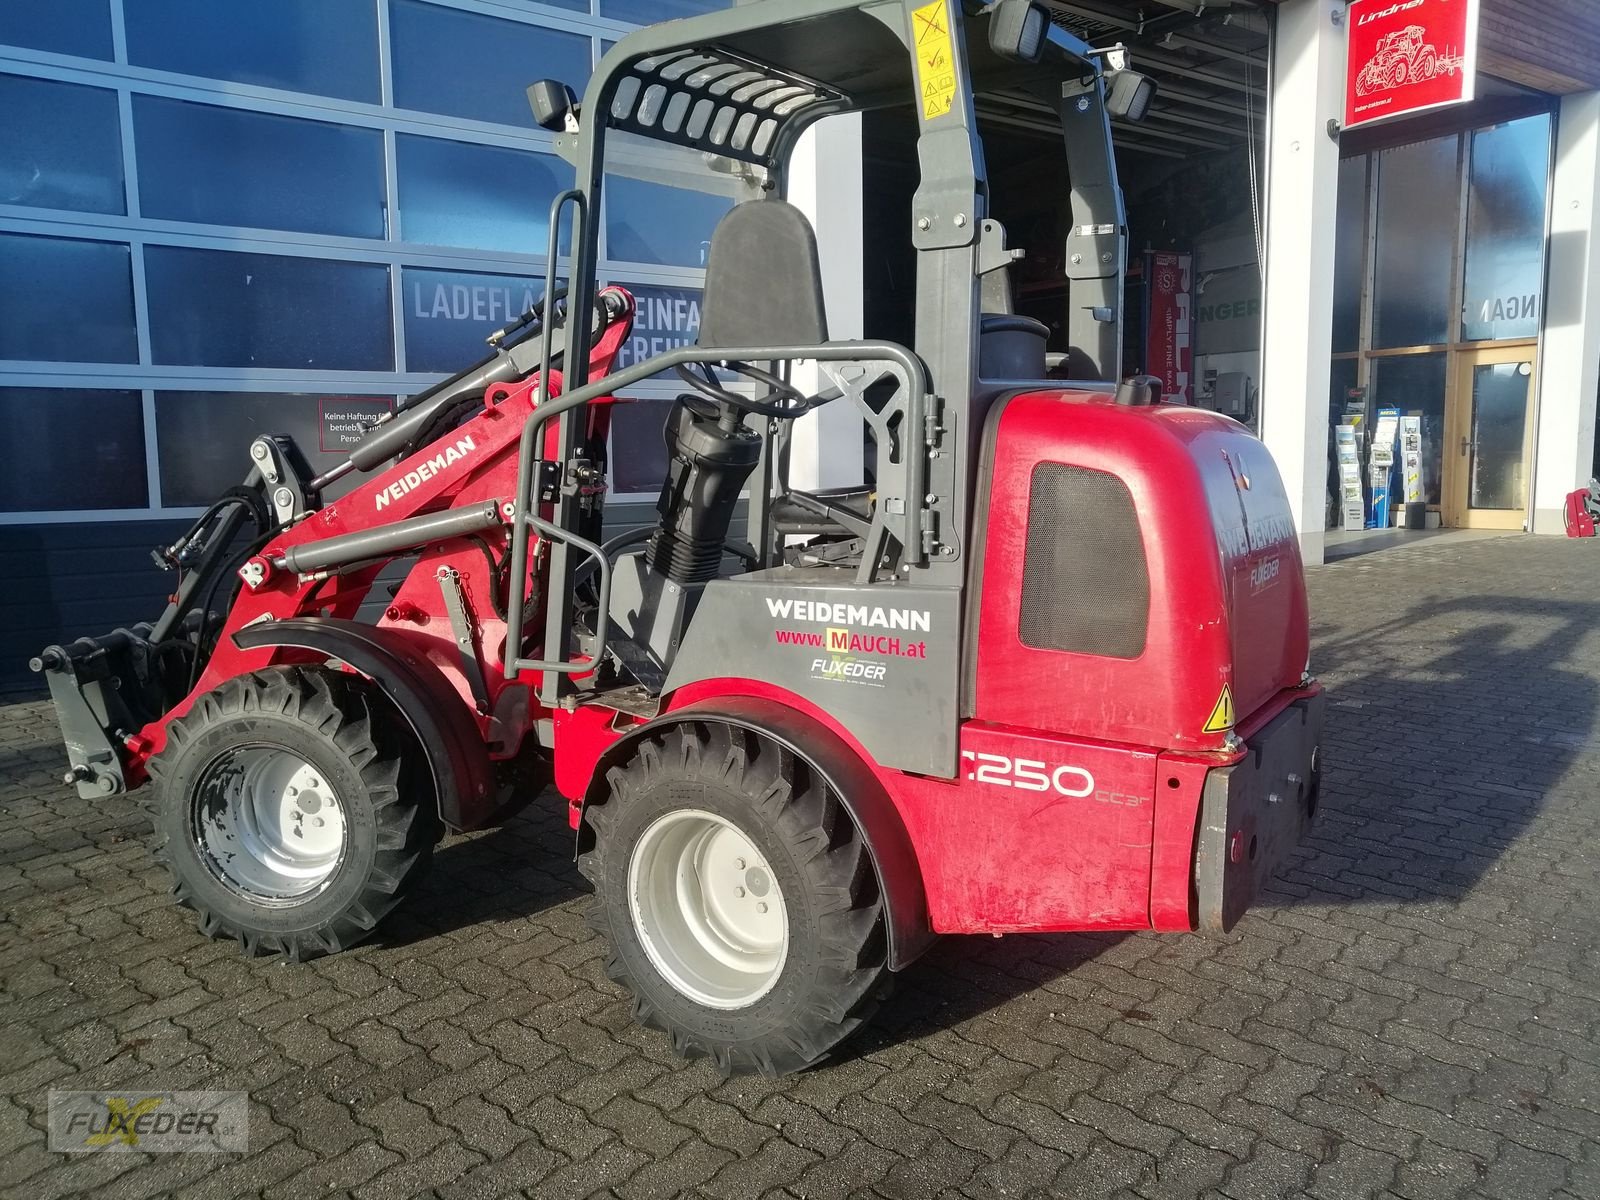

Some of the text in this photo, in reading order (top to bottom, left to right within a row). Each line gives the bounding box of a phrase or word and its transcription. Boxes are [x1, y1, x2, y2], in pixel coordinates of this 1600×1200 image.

[324, 412, 346, 421] Keine
[346, 412, 377, 422] Haftung
[765, 597, 931, 633] WEIDEMANN
